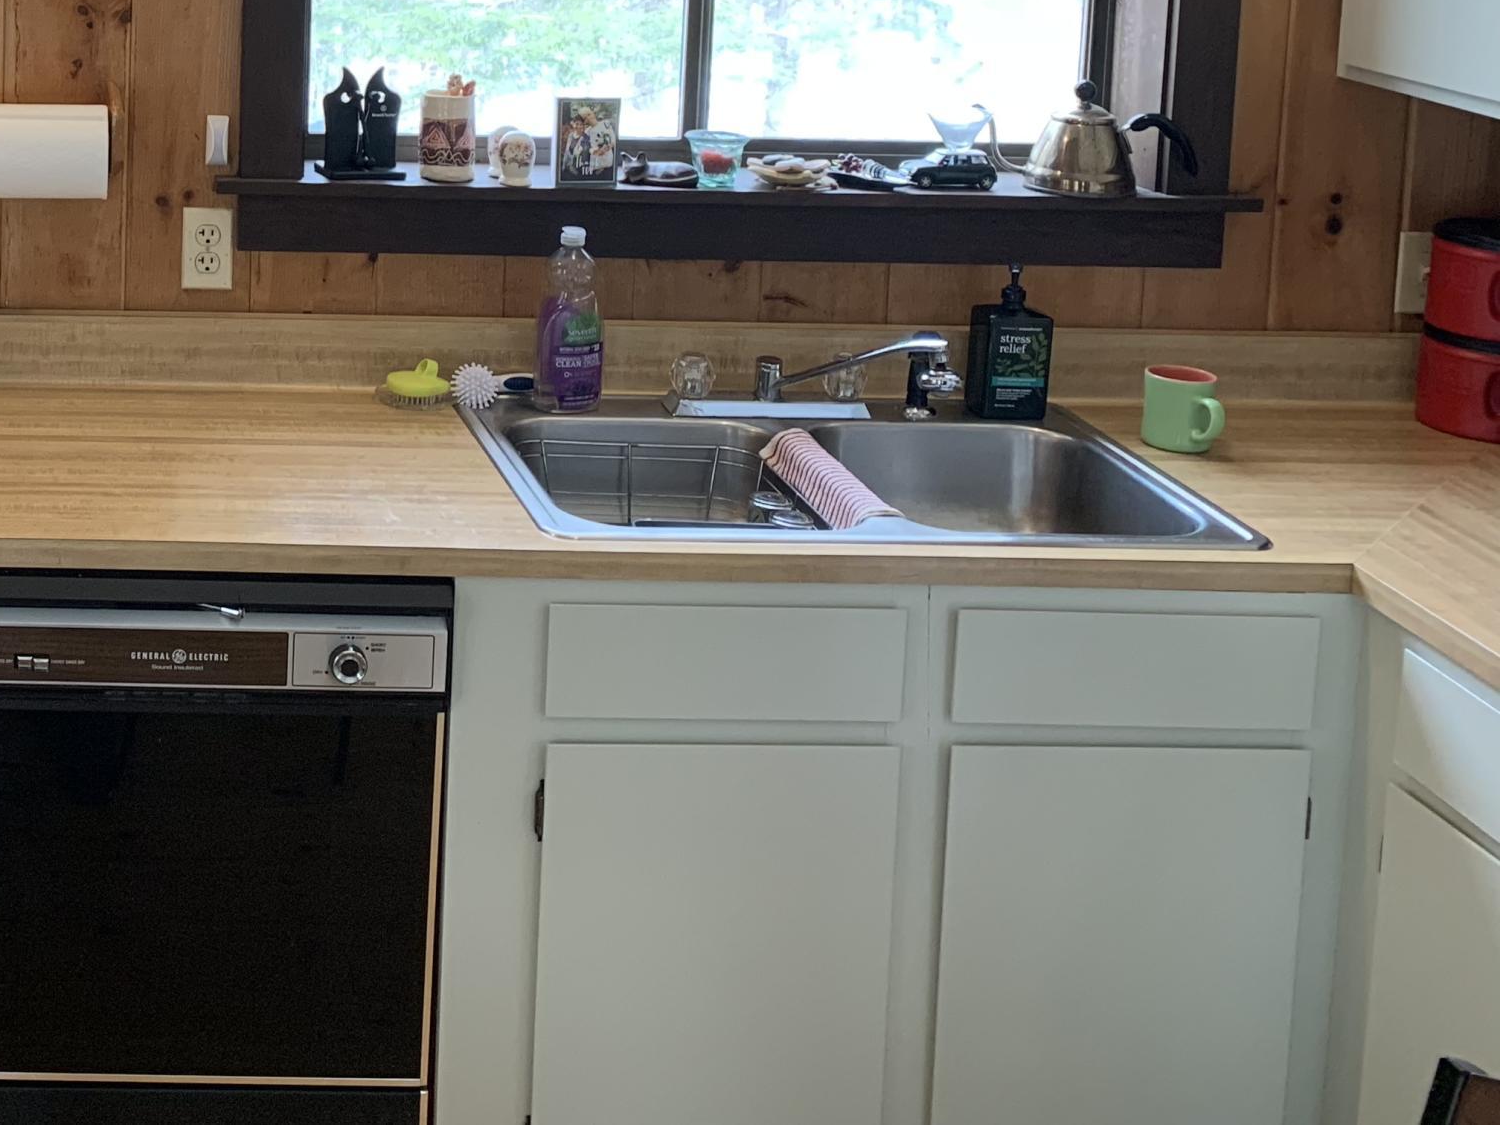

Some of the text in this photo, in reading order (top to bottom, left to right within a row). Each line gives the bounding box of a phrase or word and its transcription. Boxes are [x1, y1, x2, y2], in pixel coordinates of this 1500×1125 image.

[1000, 334, 1031, 344] stress
[999, 343, 1027, 353] relief
[130, 651, 170, 660] GENERAL
[189, 653, 229, 661] ELECTRIC
